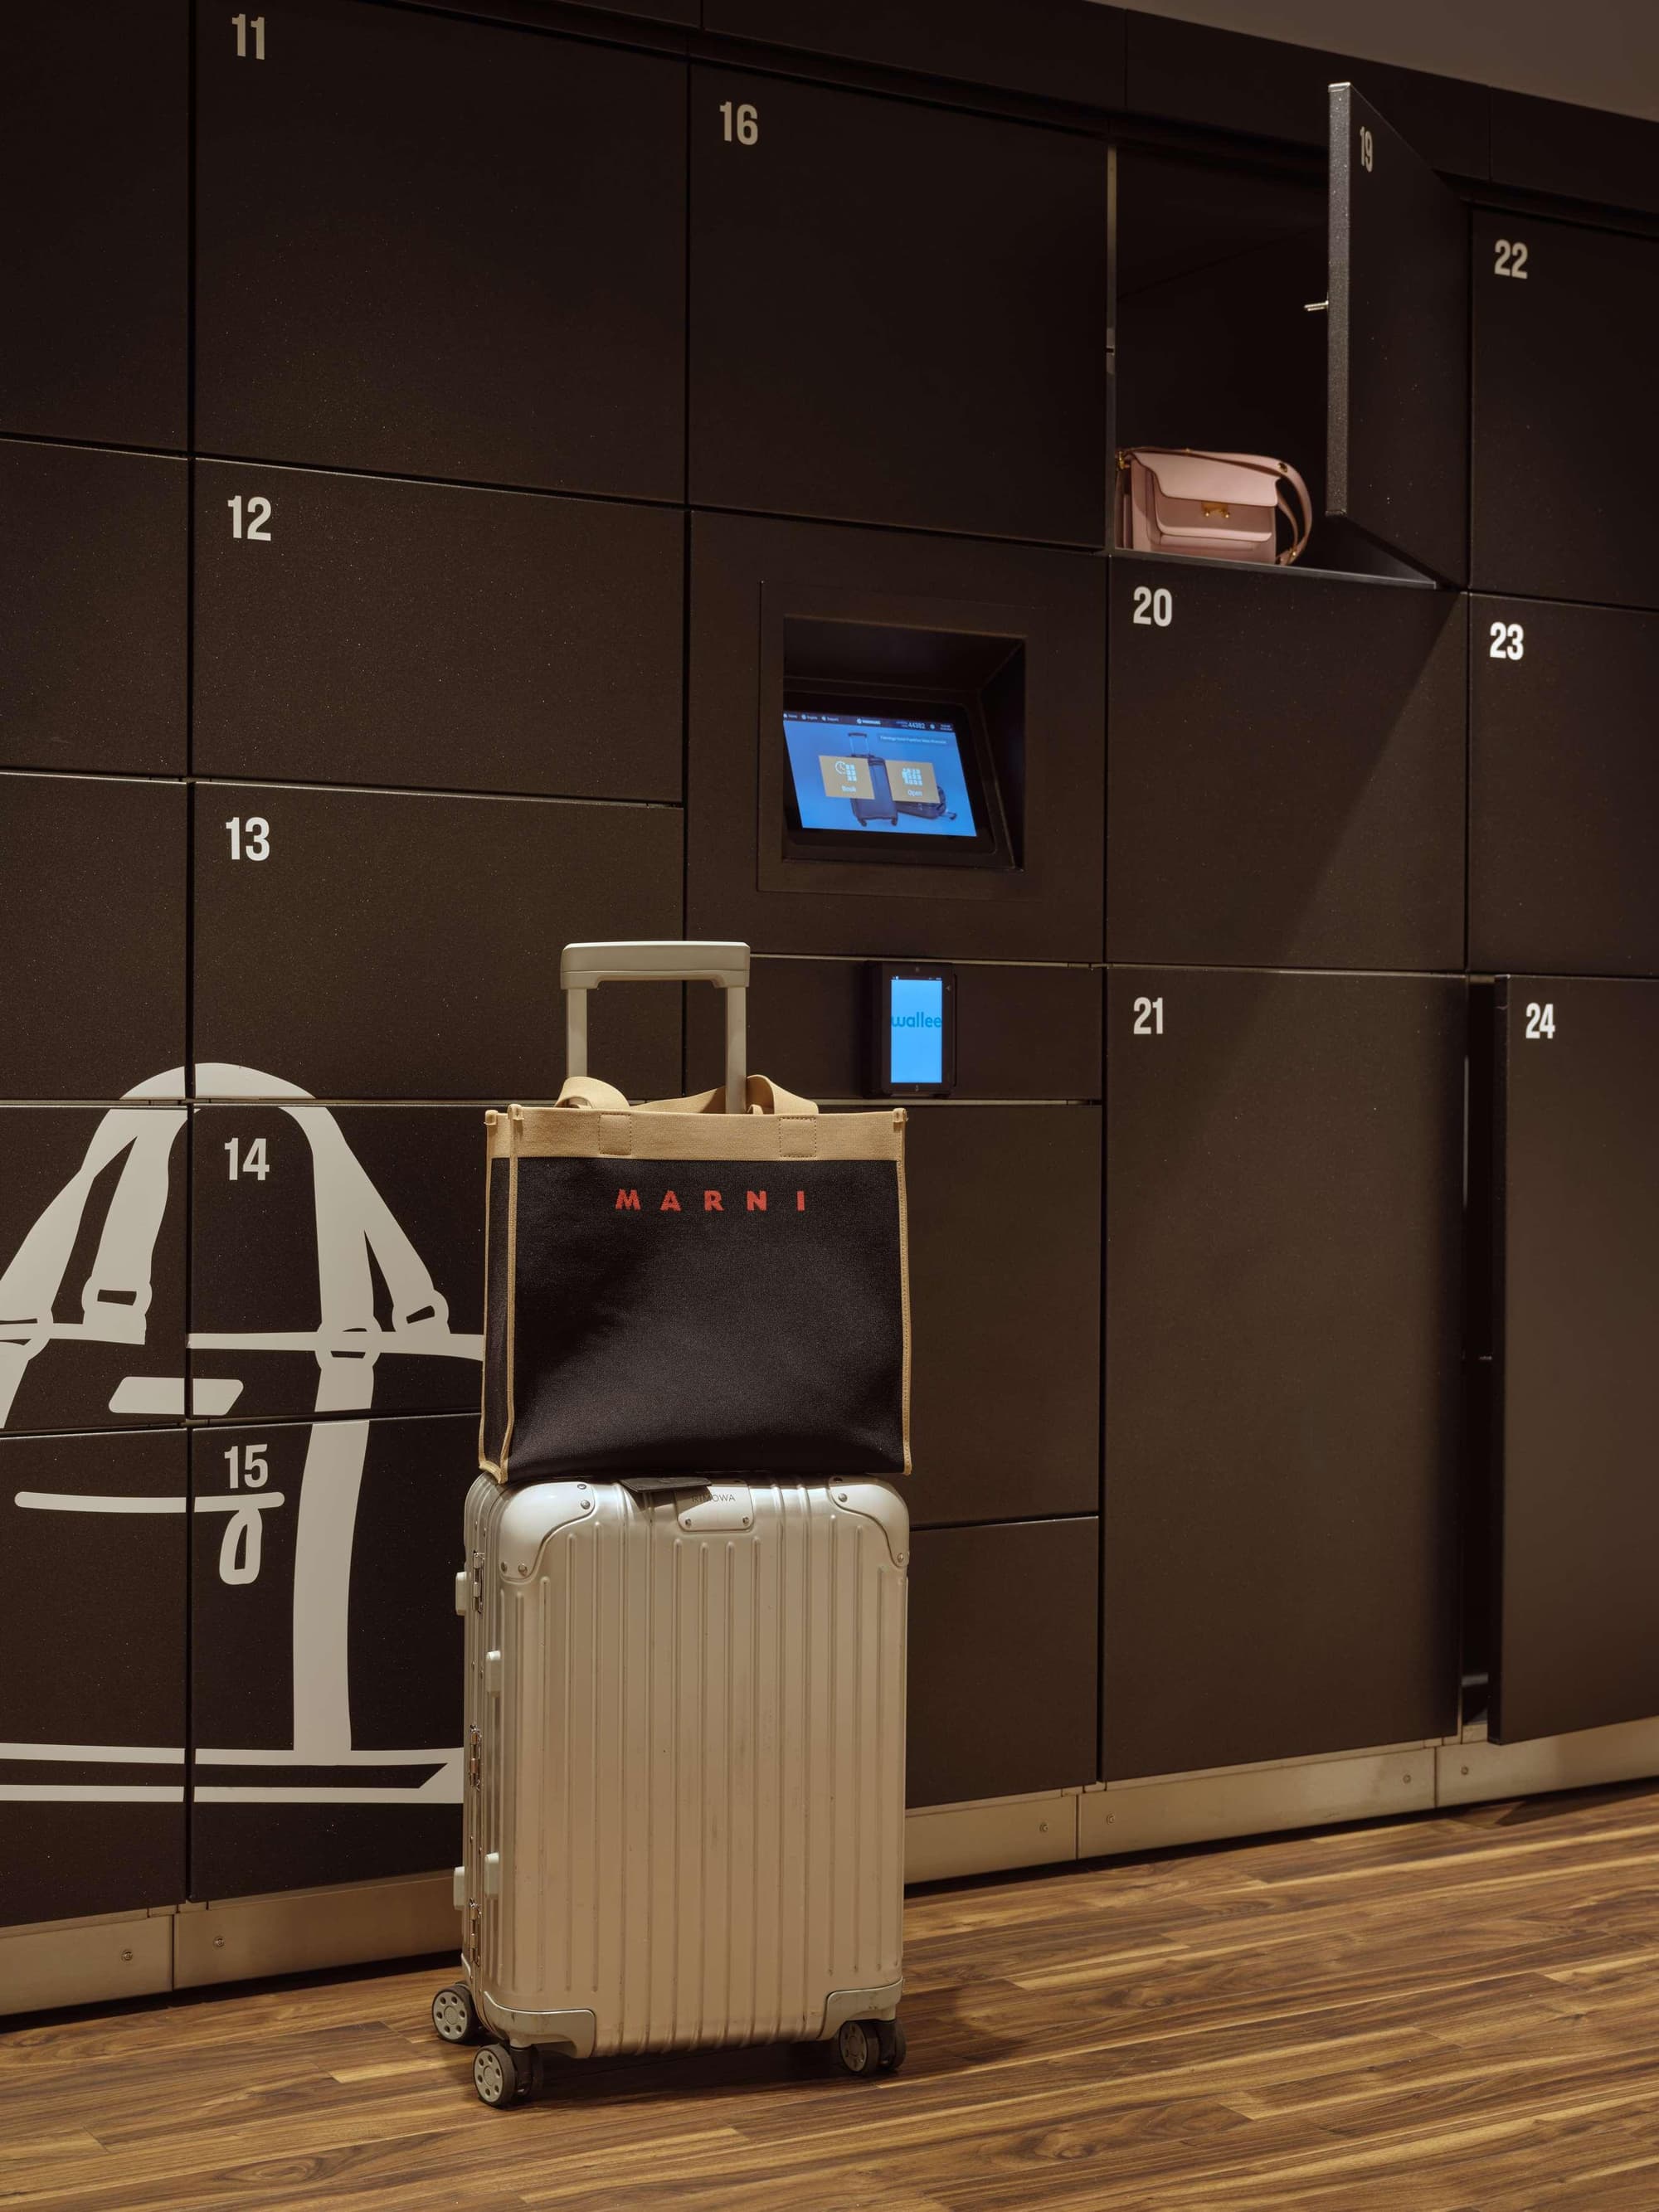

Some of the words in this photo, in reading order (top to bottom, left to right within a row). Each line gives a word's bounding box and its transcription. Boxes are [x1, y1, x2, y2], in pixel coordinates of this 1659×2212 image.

[231, 13, 266, 61] 11
[719, 101, 758, 145] 16
[1360, 126, 1373, 173] 19
[1494, 239, 1529, 280] 22
[227, 495, 271, 542] 12
[1133, 586, 1172, 627] 20
[1490, 621, 1525, 660] 23
[226, 816, 270, 862] 13
[891, 1012, 942, 1028] wallee
[1133, 997, 1164, 1035] 21
[1525, 1003, 1556, 1040] 24
[224, 1137, 270, 1181] 14
[615, 1189, 805, 1212] MARNI
[224, 1443, 269, 1489] 15
